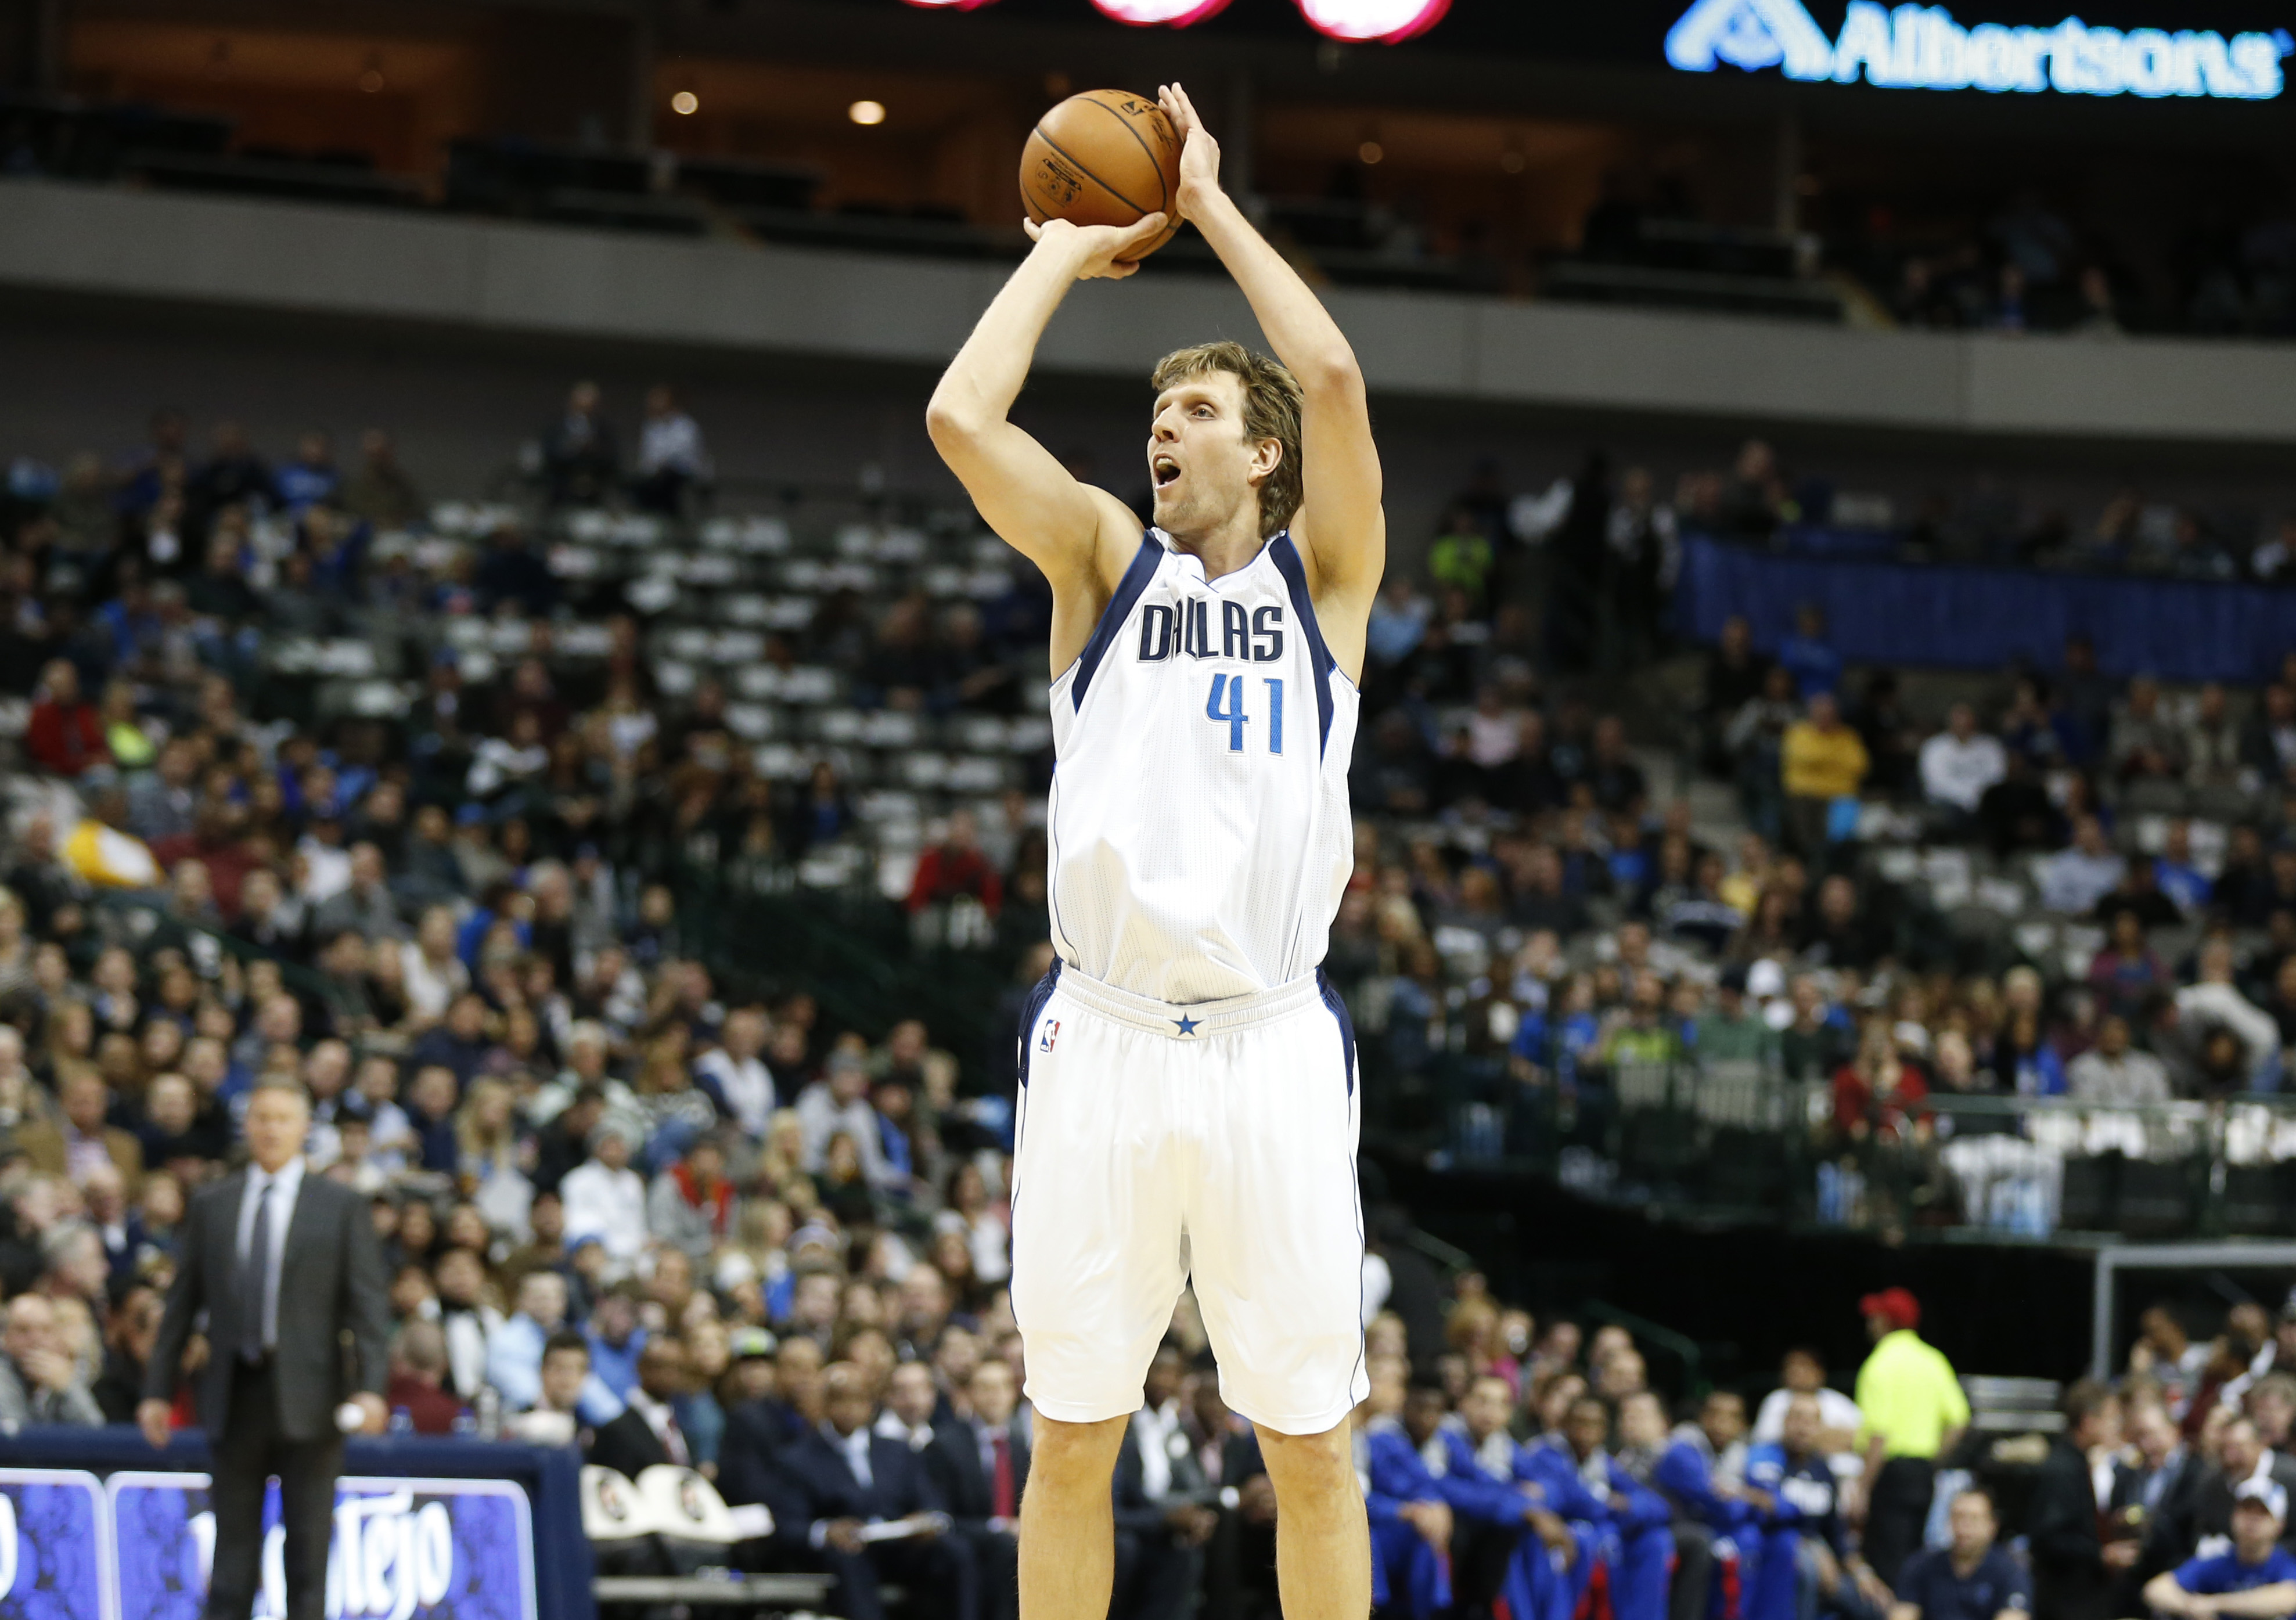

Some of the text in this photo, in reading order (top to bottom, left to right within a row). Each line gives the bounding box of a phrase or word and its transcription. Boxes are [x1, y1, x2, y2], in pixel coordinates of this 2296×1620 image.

[1831, 1, 2284, 99] Albertsons
[1137, 594, 1284, 664] DALLAS
[1204, 673, 1283, 755] 41
